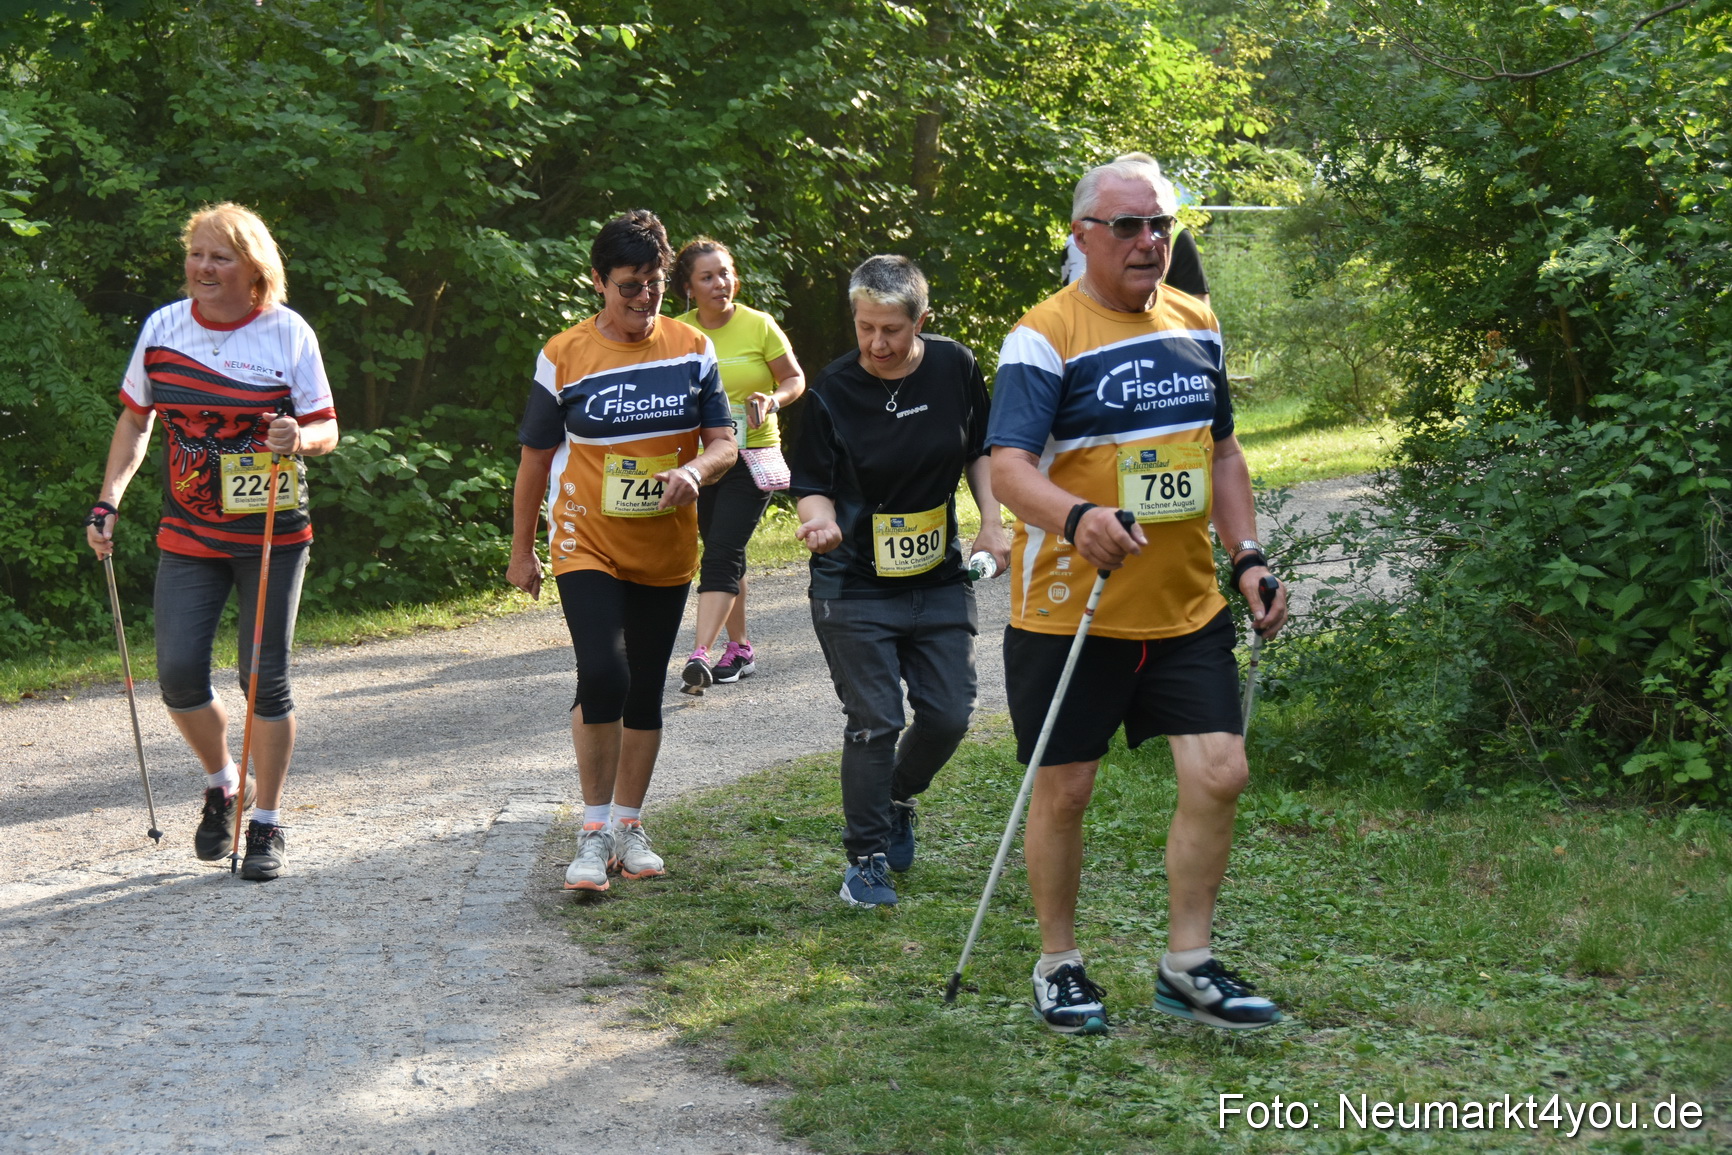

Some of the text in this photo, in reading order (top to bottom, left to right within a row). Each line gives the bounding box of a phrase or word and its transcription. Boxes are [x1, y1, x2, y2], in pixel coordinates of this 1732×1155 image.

[223, 361, 275, 376] NEUMARKT
[1122, 372, 1208, 402] Fischer
[603, 394, 688, 416] Fischer
[1133, 392, 1210, 413] AUTOMOBILE
[612, 408, 685, 424] AUTOMOBILE
[620, 478, 665, 501] 744
[1140, 470, 1192, 502] 786
[1139, 499, 1195, 510] Tischner August
[1157, 507, 1183, 515] Automobile
[884, 529, 940, 559] 1980
[910, 553, 935, 565] Christine
